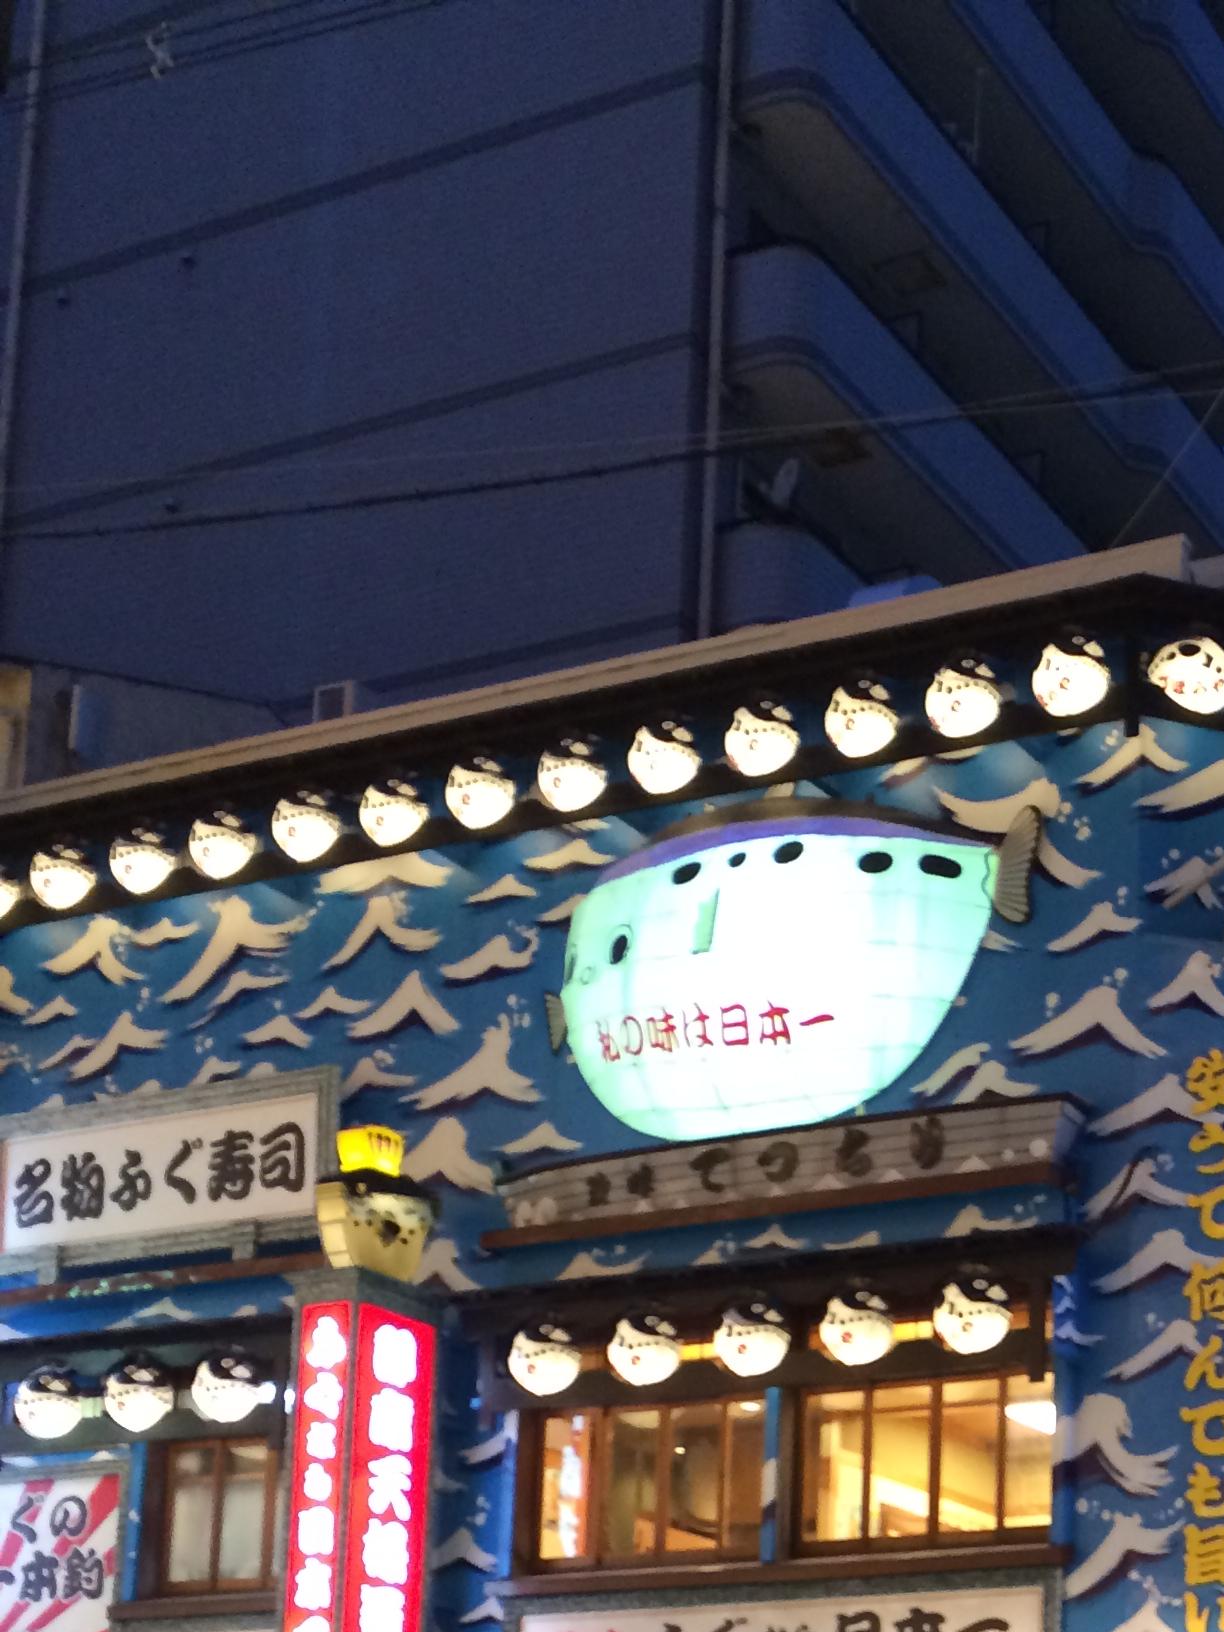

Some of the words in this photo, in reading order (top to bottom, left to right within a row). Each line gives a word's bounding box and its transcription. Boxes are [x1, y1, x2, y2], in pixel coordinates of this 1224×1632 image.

[13, 1122, 305, 1229] 名物ふぐ寿司
